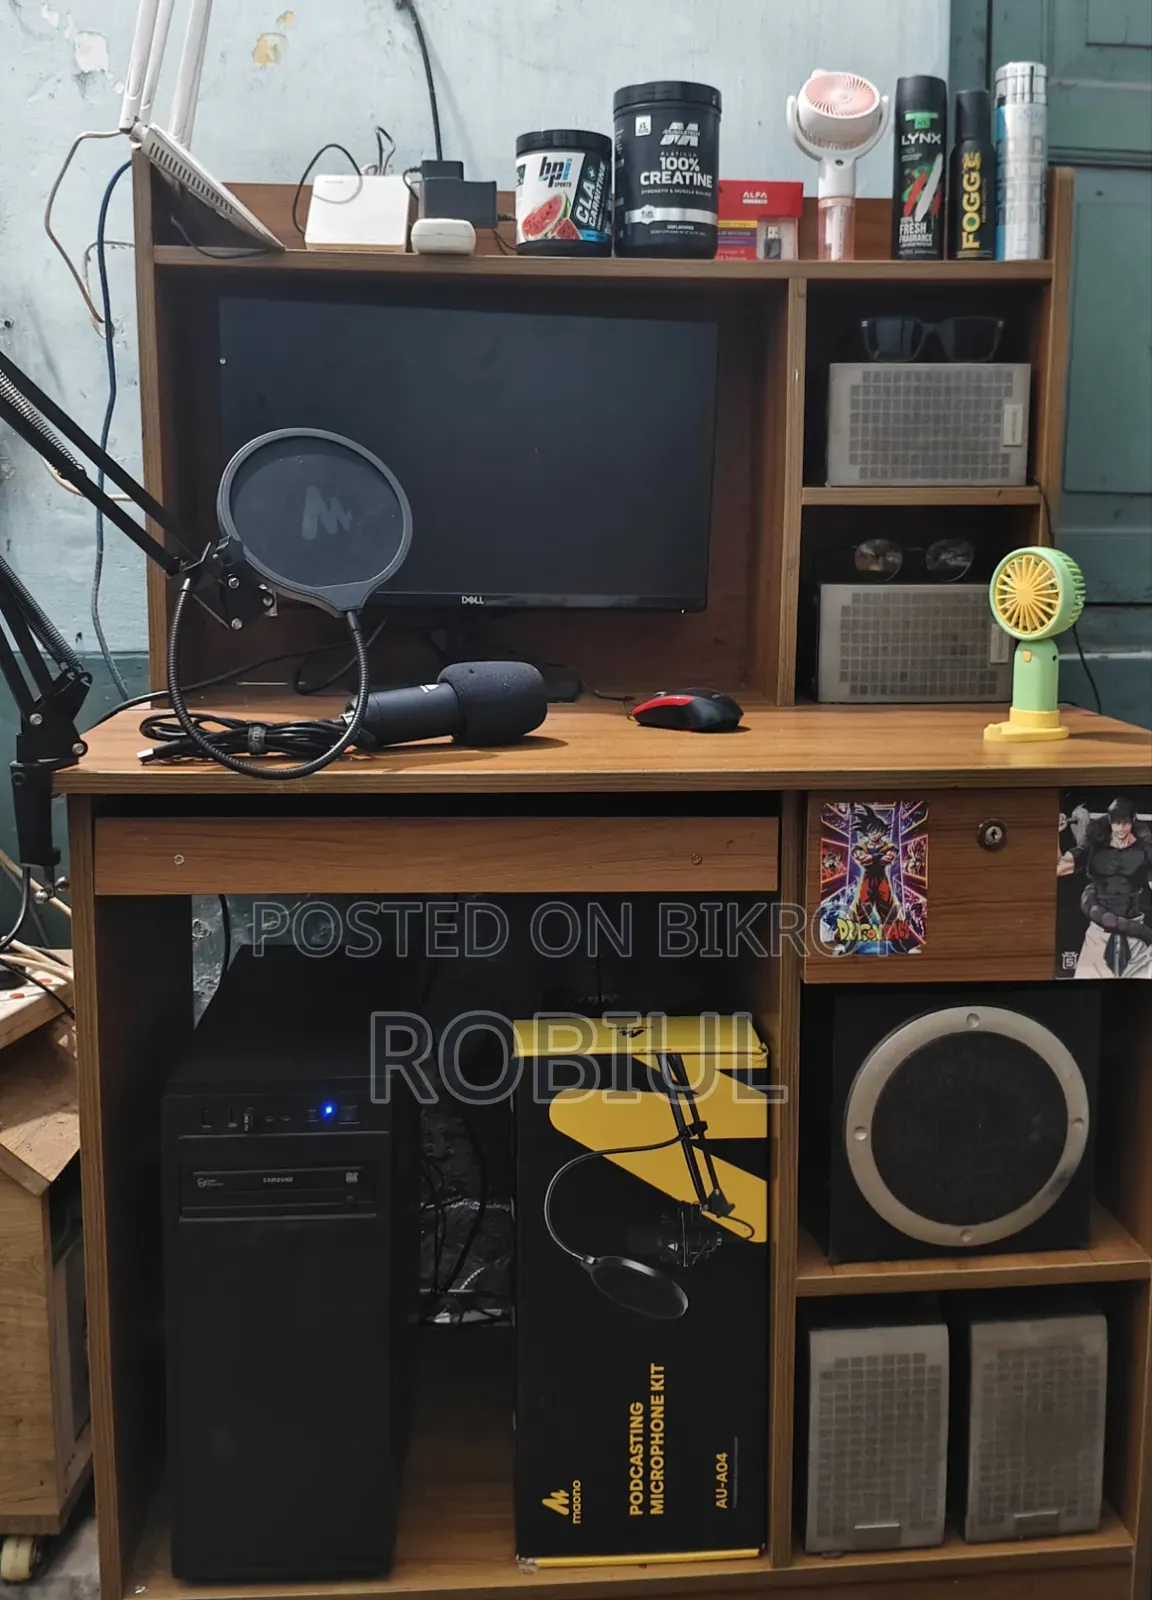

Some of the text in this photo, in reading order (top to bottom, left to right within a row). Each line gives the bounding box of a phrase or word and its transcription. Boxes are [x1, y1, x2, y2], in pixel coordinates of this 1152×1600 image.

[901, 131, 942, 146] LYNX
[539, 156, 573, 188] bpi
[640, 171, 713, 188] CREATINE
[659, 156, 700, 171] 100%
[575, 181, 597, 224] CLA
[588, 161, 607, 227] CARNITINE
[742, 191, 767, 200] ALFA
[899, 222, 927, 235] FRESH
[461, 595, 485, 605] DELL
[650, 1362, 665, 1516] MICROPHONE KIT
[629, 1401, 644, 1516] PODCASTING
[715, 1452, 728, 1509] AU-A04
[572, 1479, 581, 1524] maono
